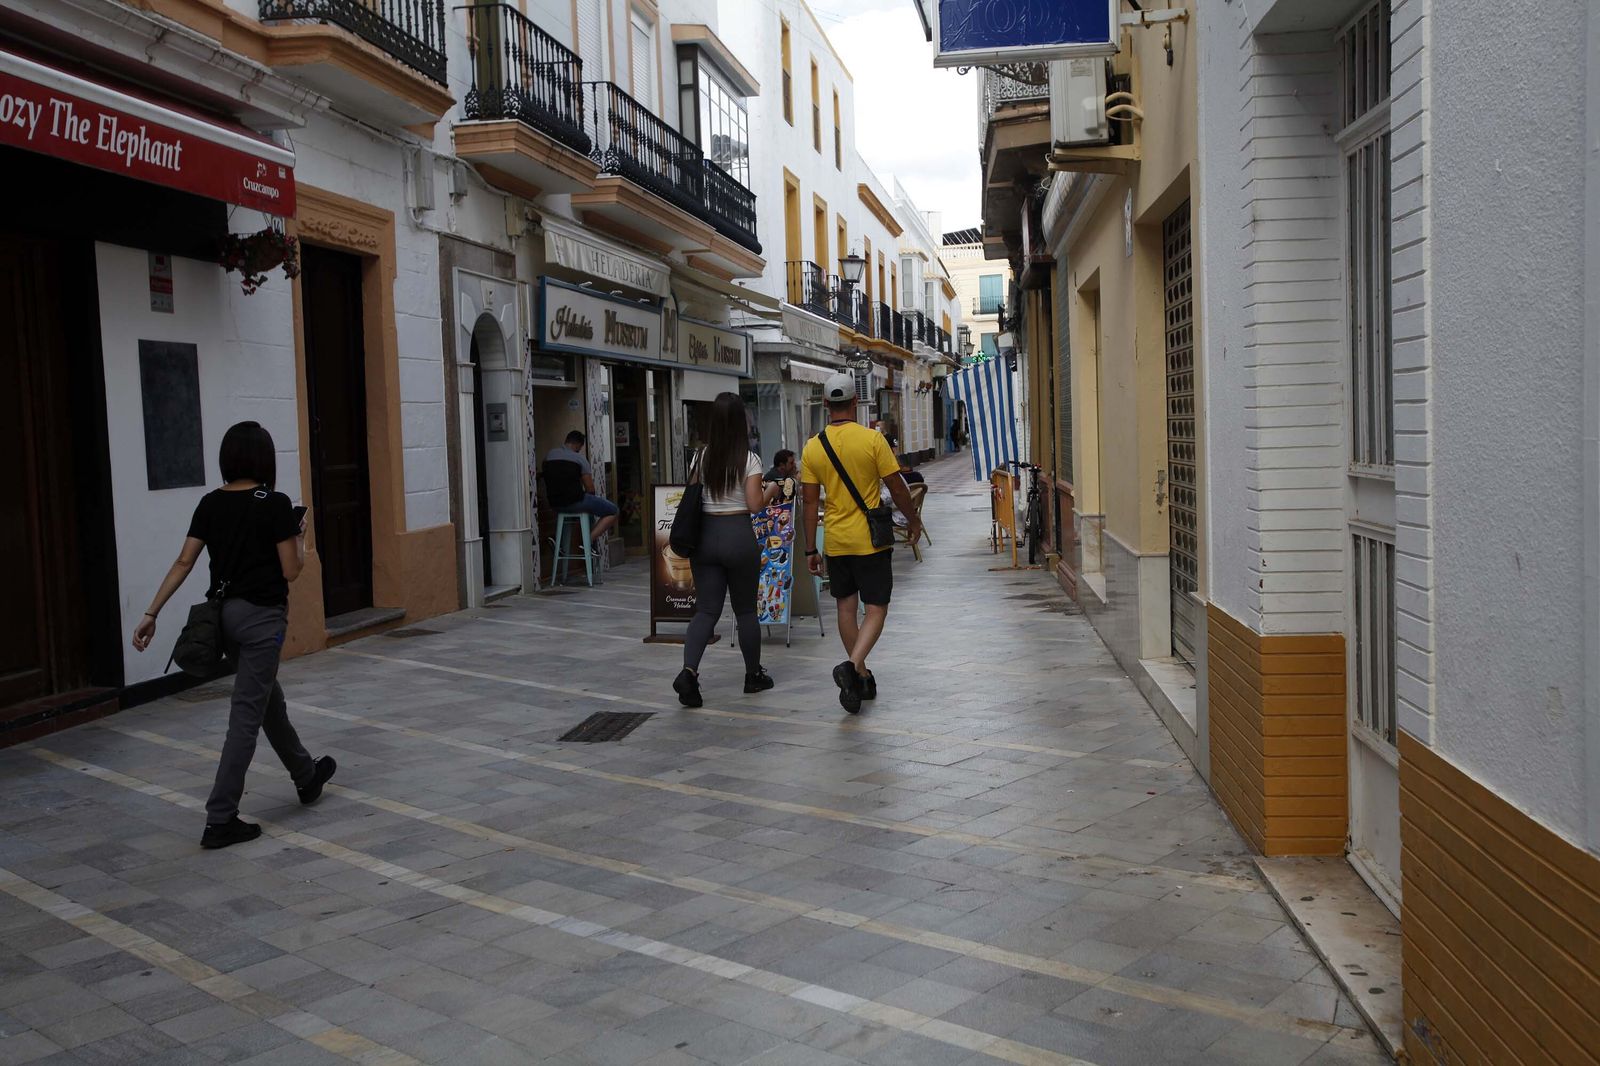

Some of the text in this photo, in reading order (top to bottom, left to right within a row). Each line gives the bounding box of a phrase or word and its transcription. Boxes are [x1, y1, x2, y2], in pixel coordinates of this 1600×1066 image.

[50, 98, 91, 146] The
[96, 113, 183, 172] Elephant
[243, 177, 280, 199] Cruzcampo
[591, 250, 654, 290] HELADERIA
[687, 594, 697, 604] Caf
